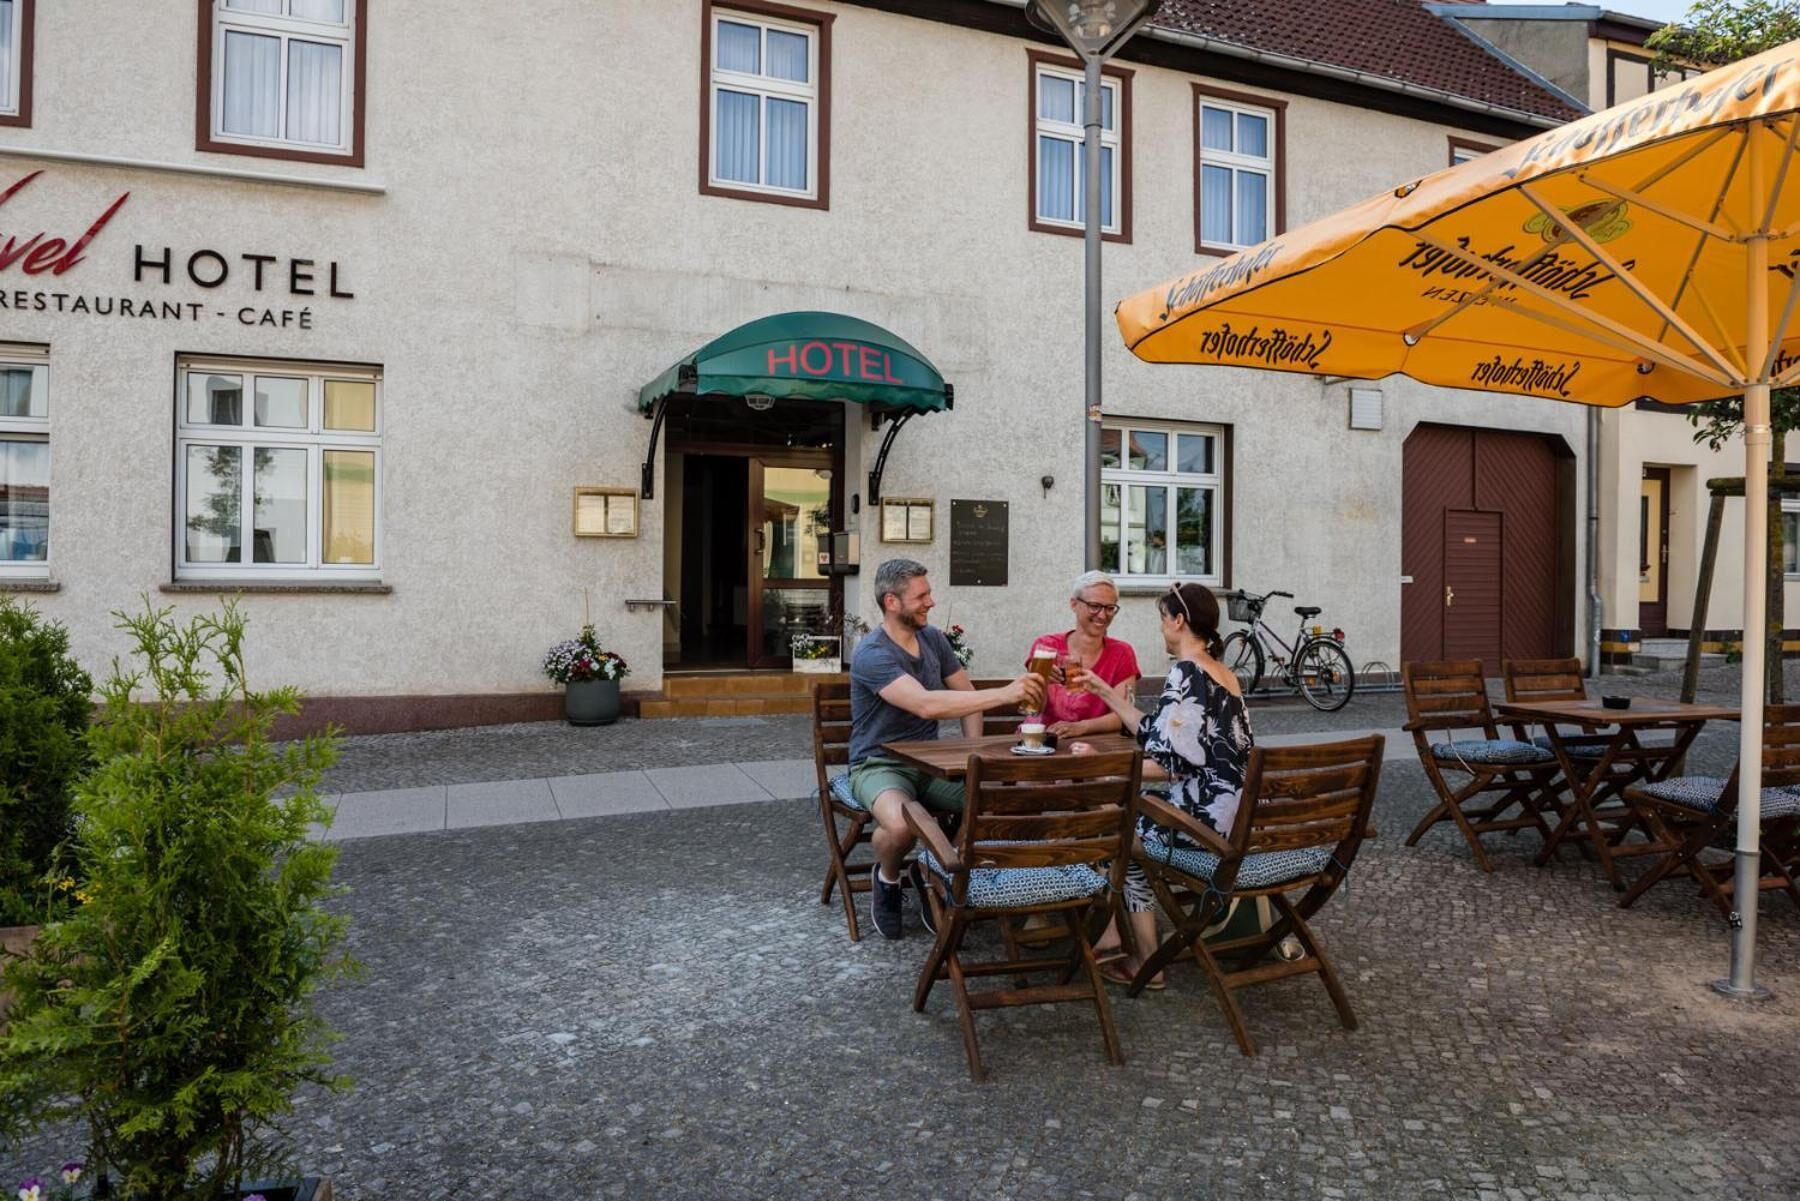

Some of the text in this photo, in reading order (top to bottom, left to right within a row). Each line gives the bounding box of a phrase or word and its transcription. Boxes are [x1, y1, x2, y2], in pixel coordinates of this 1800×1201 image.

[134, 244, 354, 299] HOTEL
[0, 289, 203, 322] RESTAURANT
[238, 306, 312, 330] CAFÉ
[767, 340, 903, 384] HOTEL
